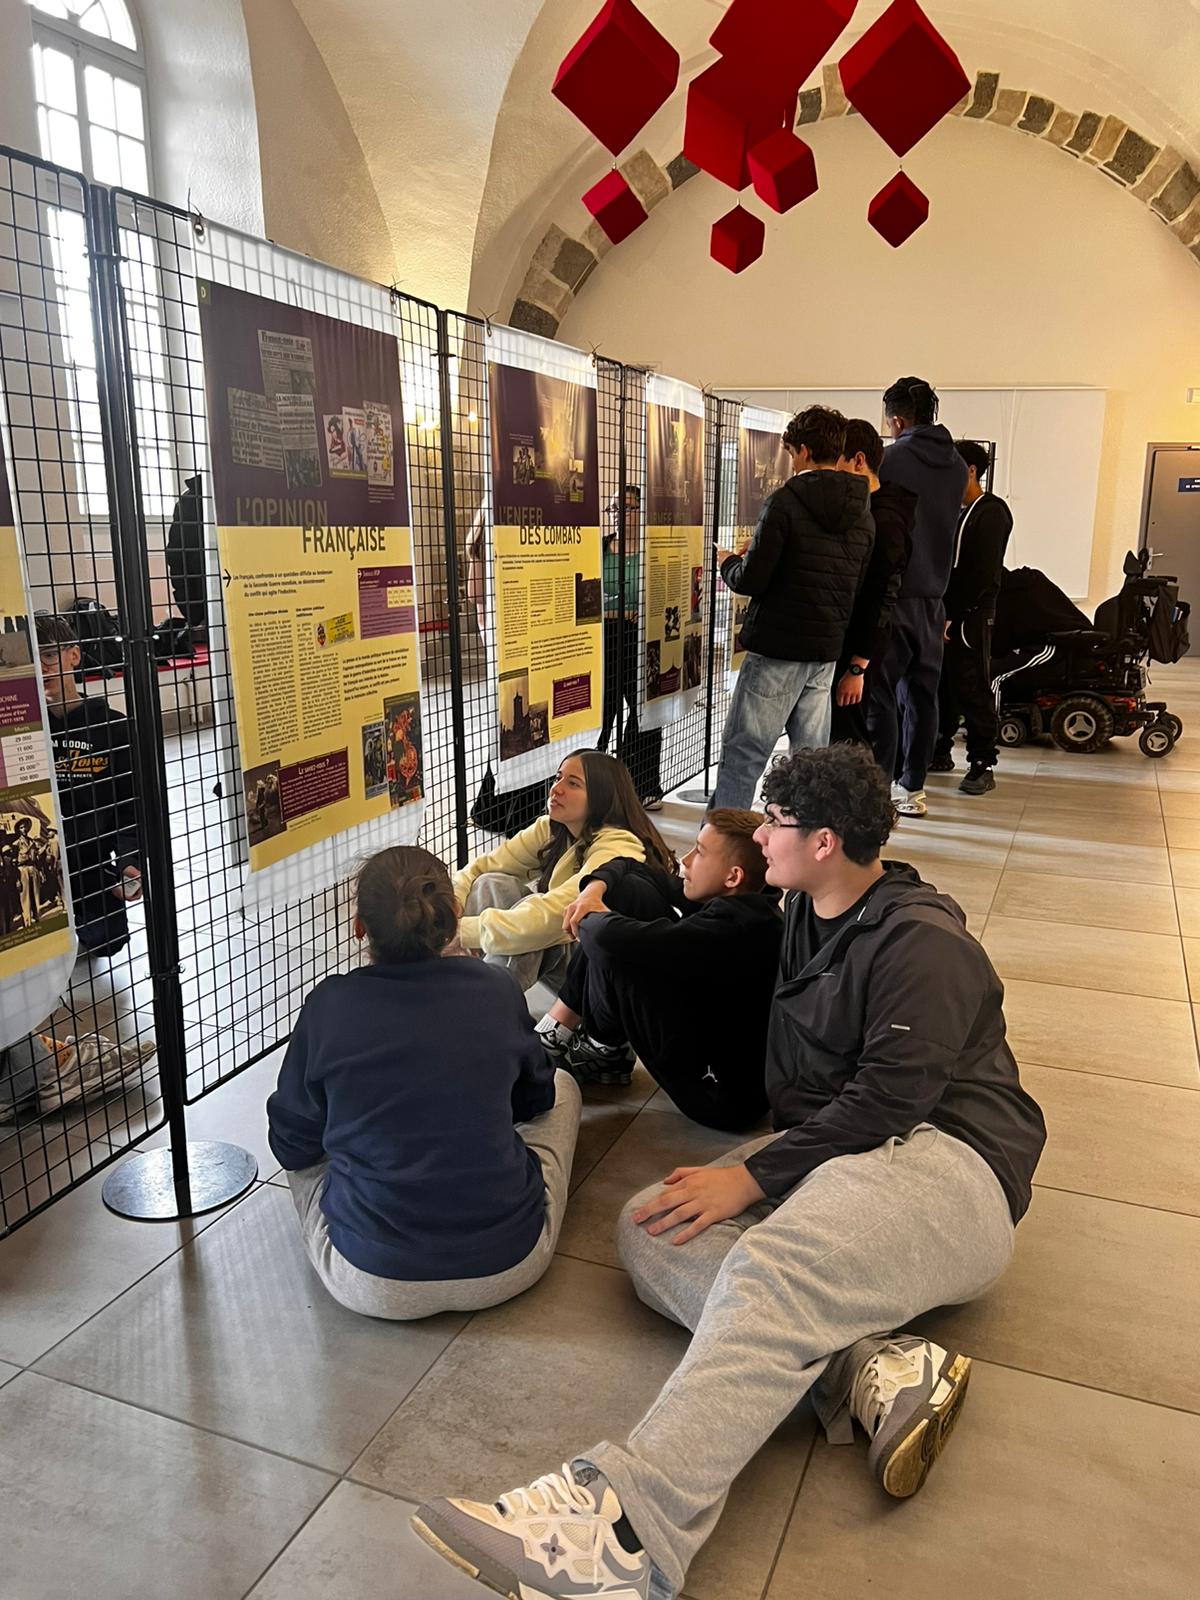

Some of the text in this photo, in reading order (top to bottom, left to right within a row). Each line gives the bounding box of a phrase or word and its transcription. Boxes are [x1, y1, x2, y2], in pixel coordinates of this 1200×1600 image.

[236, 497, 328, 527] L'OPINION
[500, 506, 543, 526] L'ENFER
[303, 527, 386, 560] FRANÇAISE
[520, 526, 581, 545] DES COMBATS
